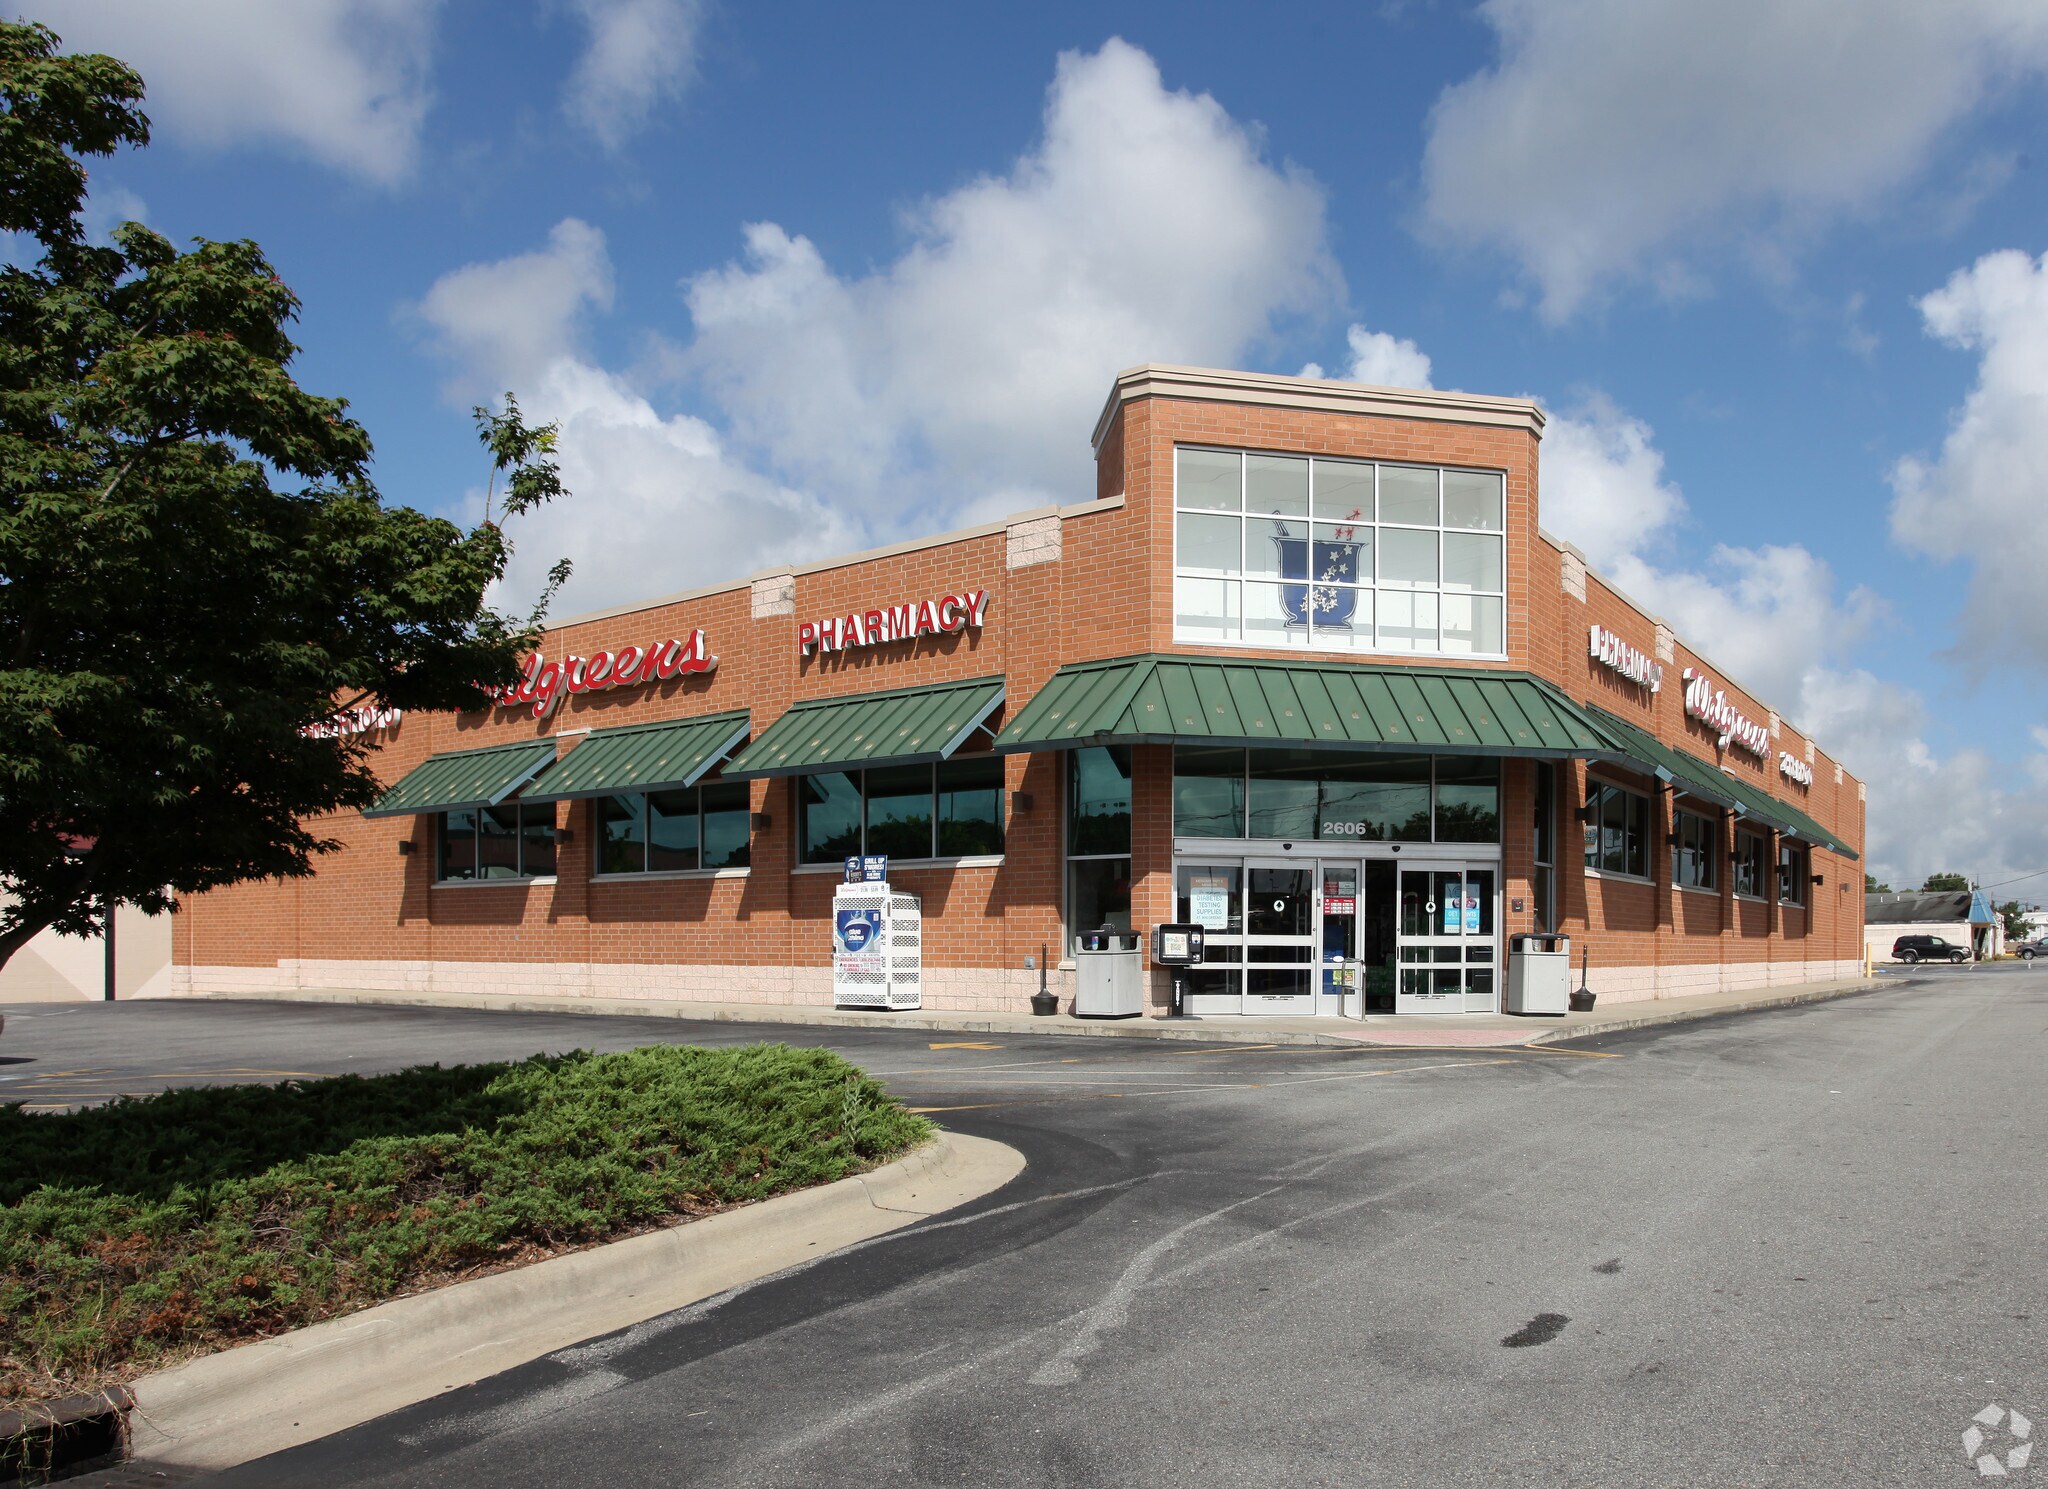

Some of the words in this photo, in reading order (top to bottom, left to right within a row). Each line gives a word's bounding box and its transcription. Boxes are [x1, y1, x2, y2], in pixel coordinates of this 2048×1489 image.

[799, 589, 990, 656] PHARMACY
[472, 628, 718, 719] lgreens
[1323, 822, 1366, 835] 2606
